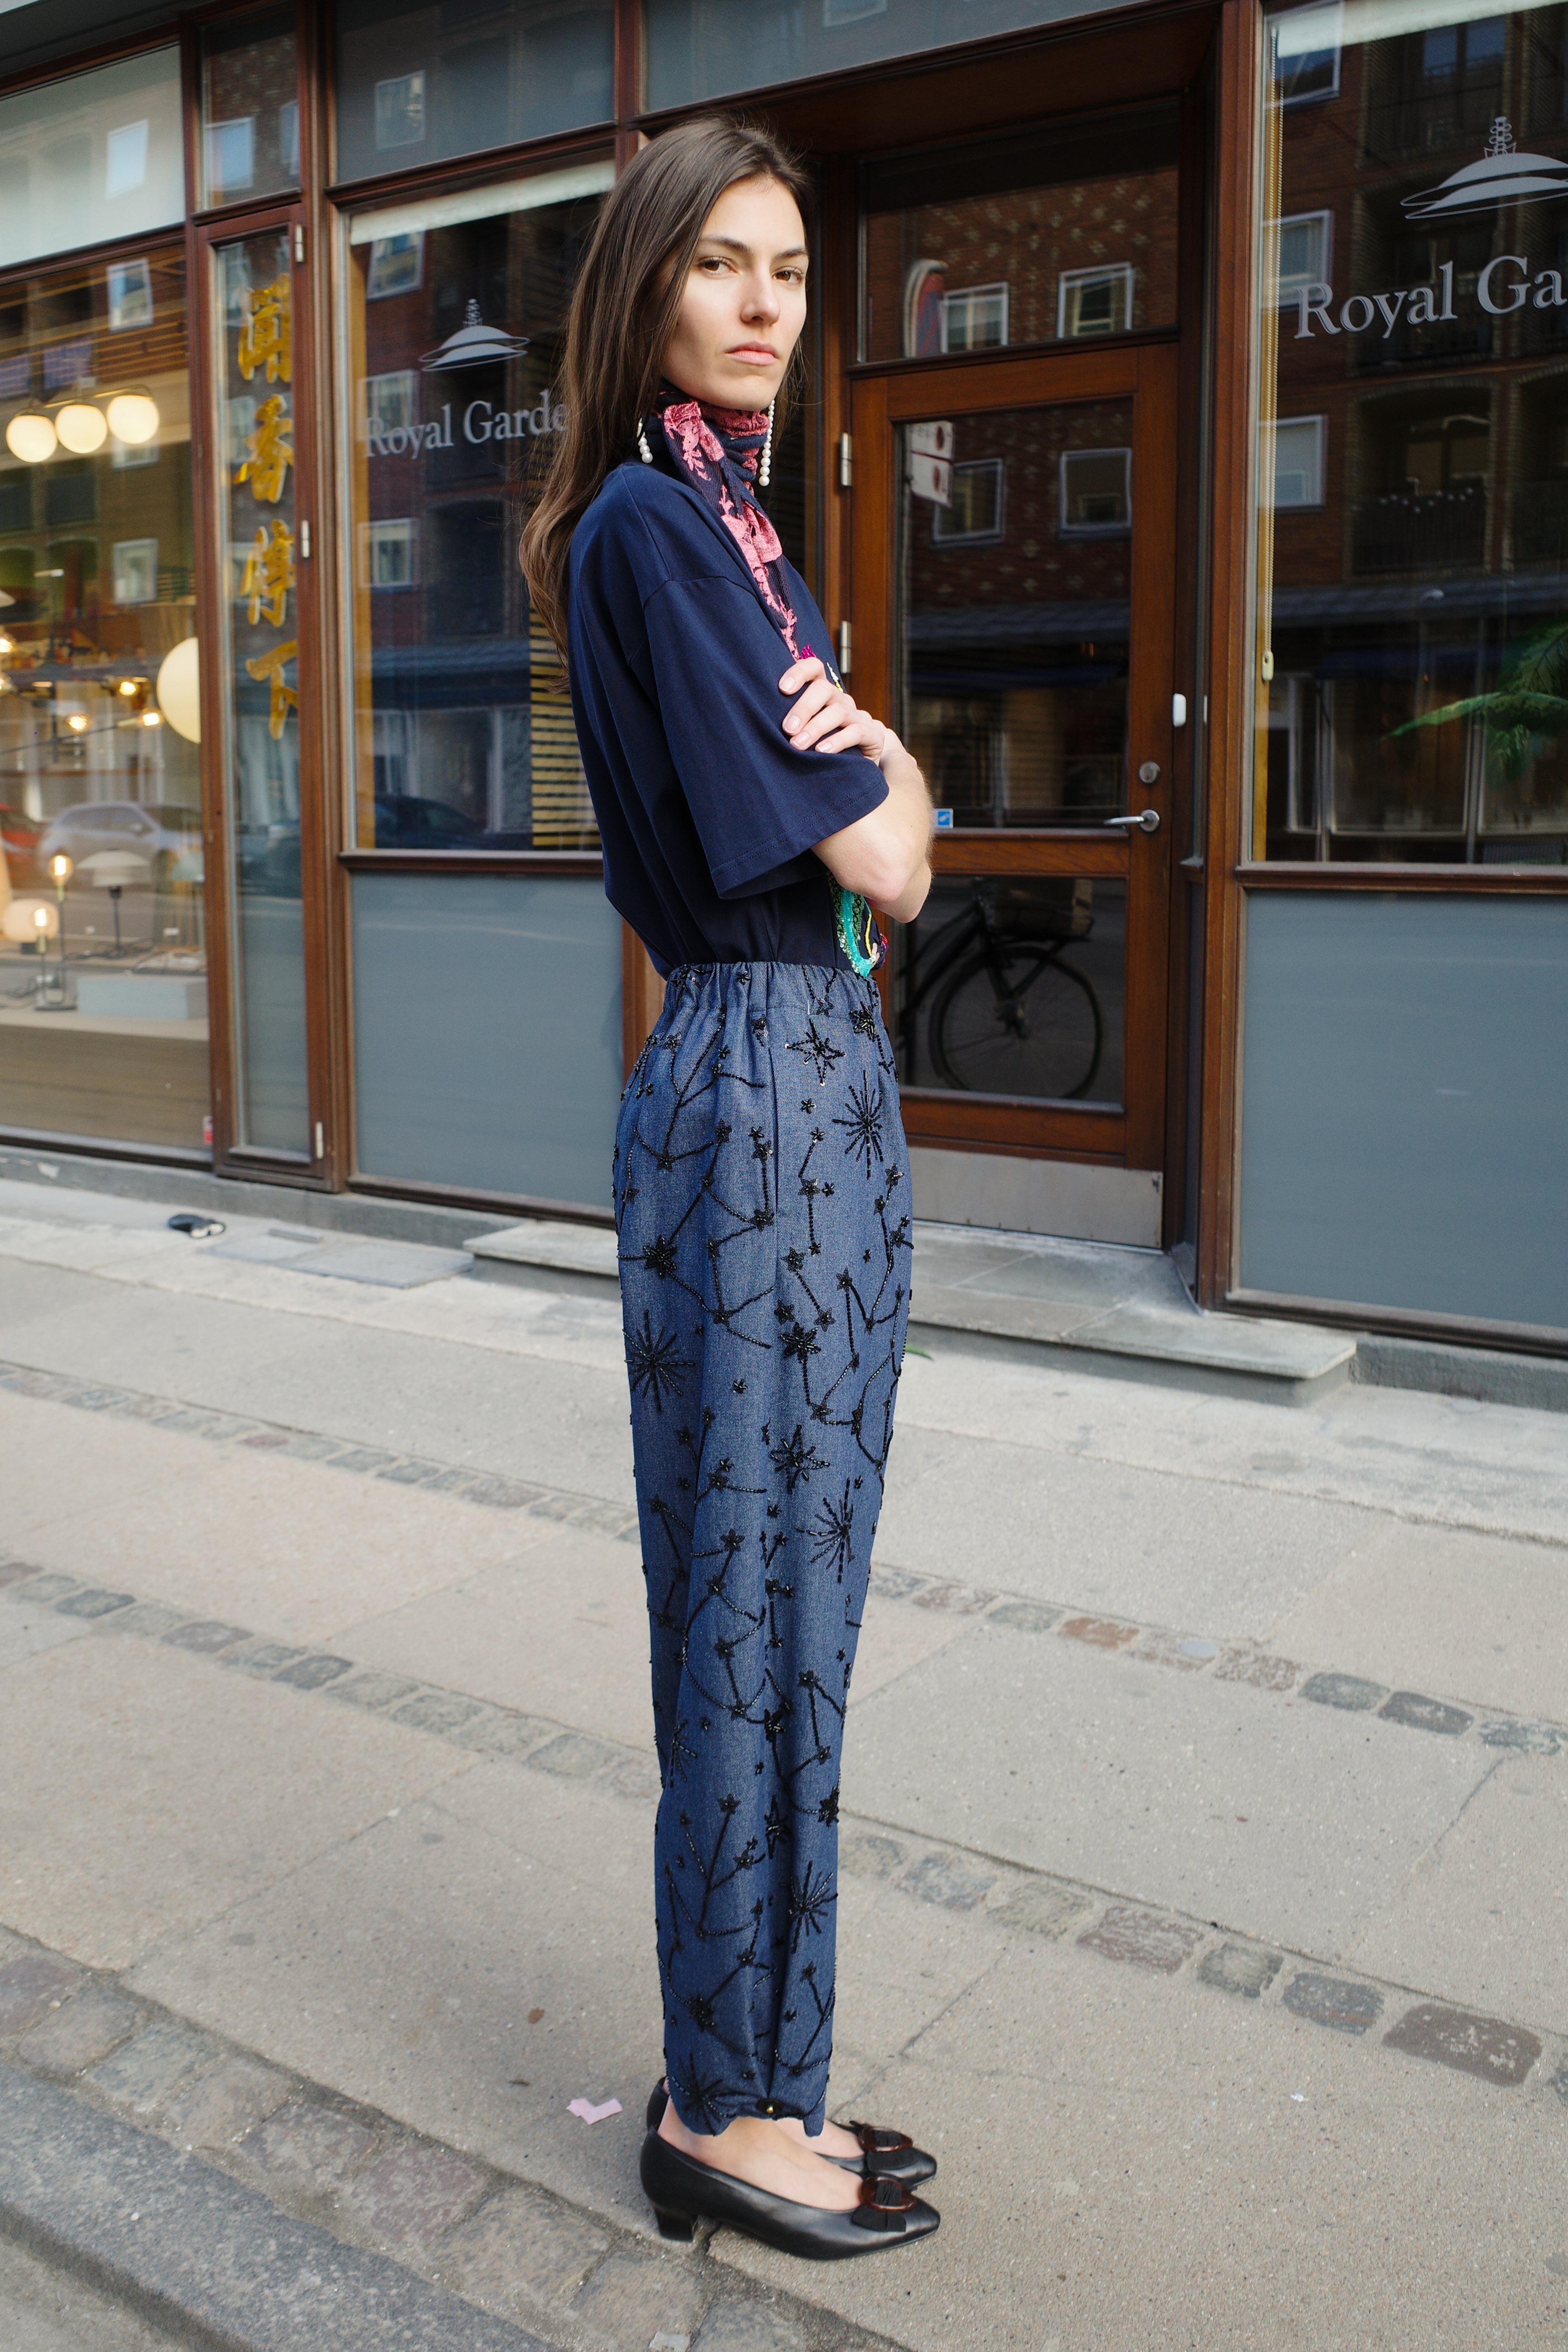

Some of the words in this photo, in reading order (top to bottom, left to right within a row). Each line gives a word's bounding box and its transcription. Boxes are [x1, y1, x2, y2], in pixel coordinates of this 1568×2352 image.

[1294, 260, 1458, 339] Royal
[364, 403, 454, 459] Royal
[463, 389, 569, 444] Garde
